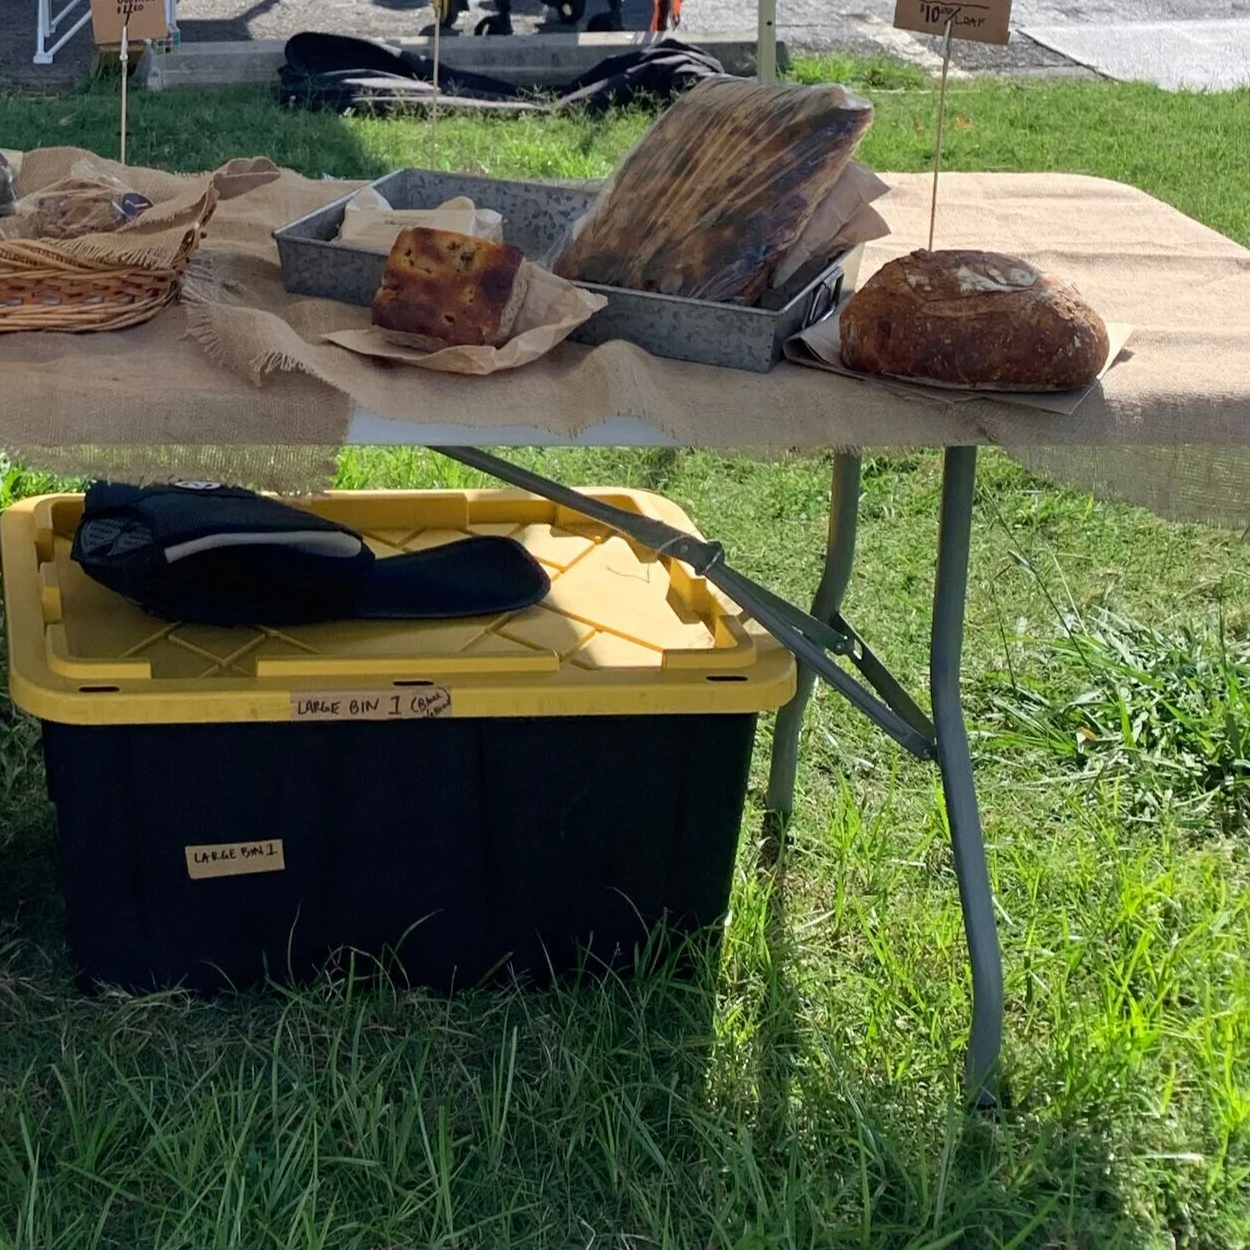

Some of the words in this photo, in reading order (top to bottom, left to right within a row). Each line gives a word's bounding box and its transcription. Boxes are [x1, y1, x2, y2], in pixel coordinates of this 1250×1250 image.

[297, 700, 340, 715] LARGE
[349, 698, 380, 715] BIN
[194, 849, 237, 863] LARGE
[241, 845, 264, 859] BIN
